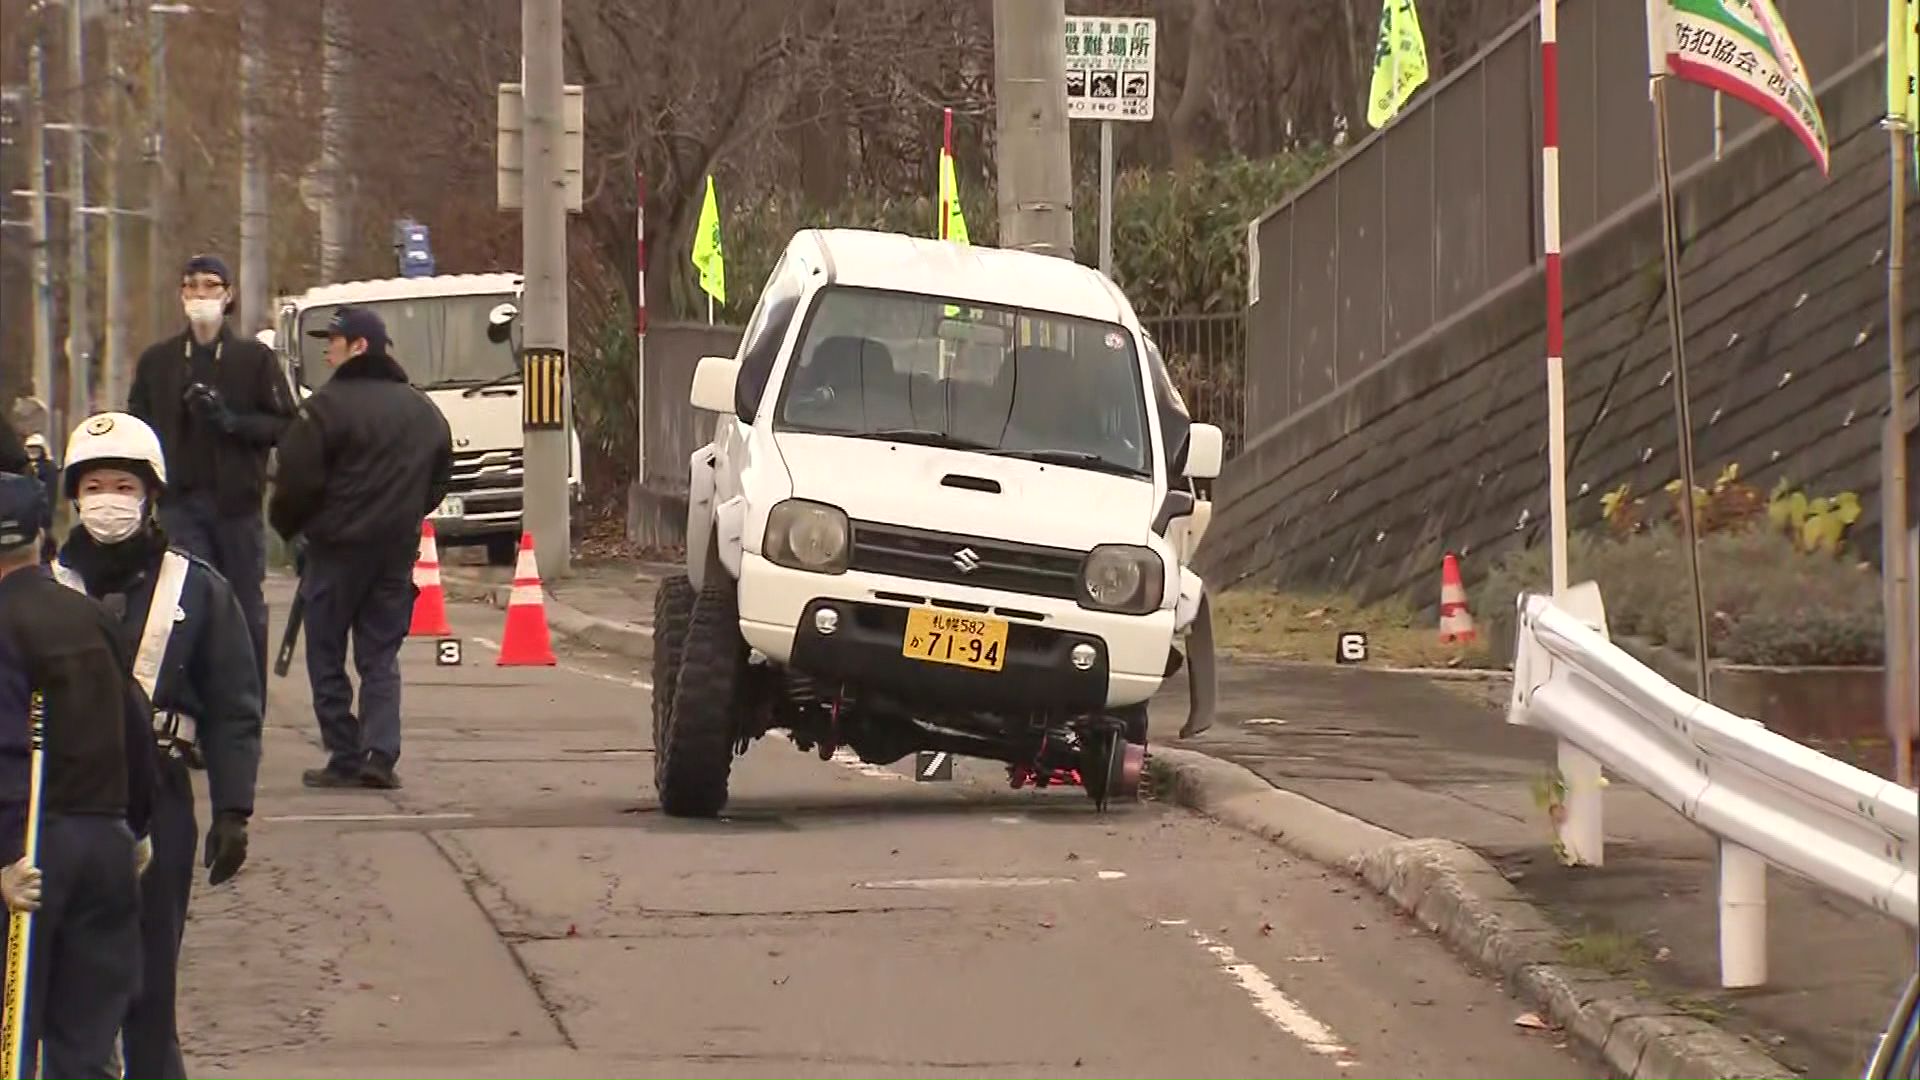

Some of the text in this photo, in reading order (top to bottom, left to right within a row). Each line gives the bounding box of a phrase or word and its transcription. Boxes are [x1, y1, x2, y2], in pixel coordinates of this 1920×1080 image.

[439, 641, 460, 663] 3
[927, 631, 998, 666] 71-94
[1341, 634, 1365, 660] 6
[919, 749, 947, 777] 7
